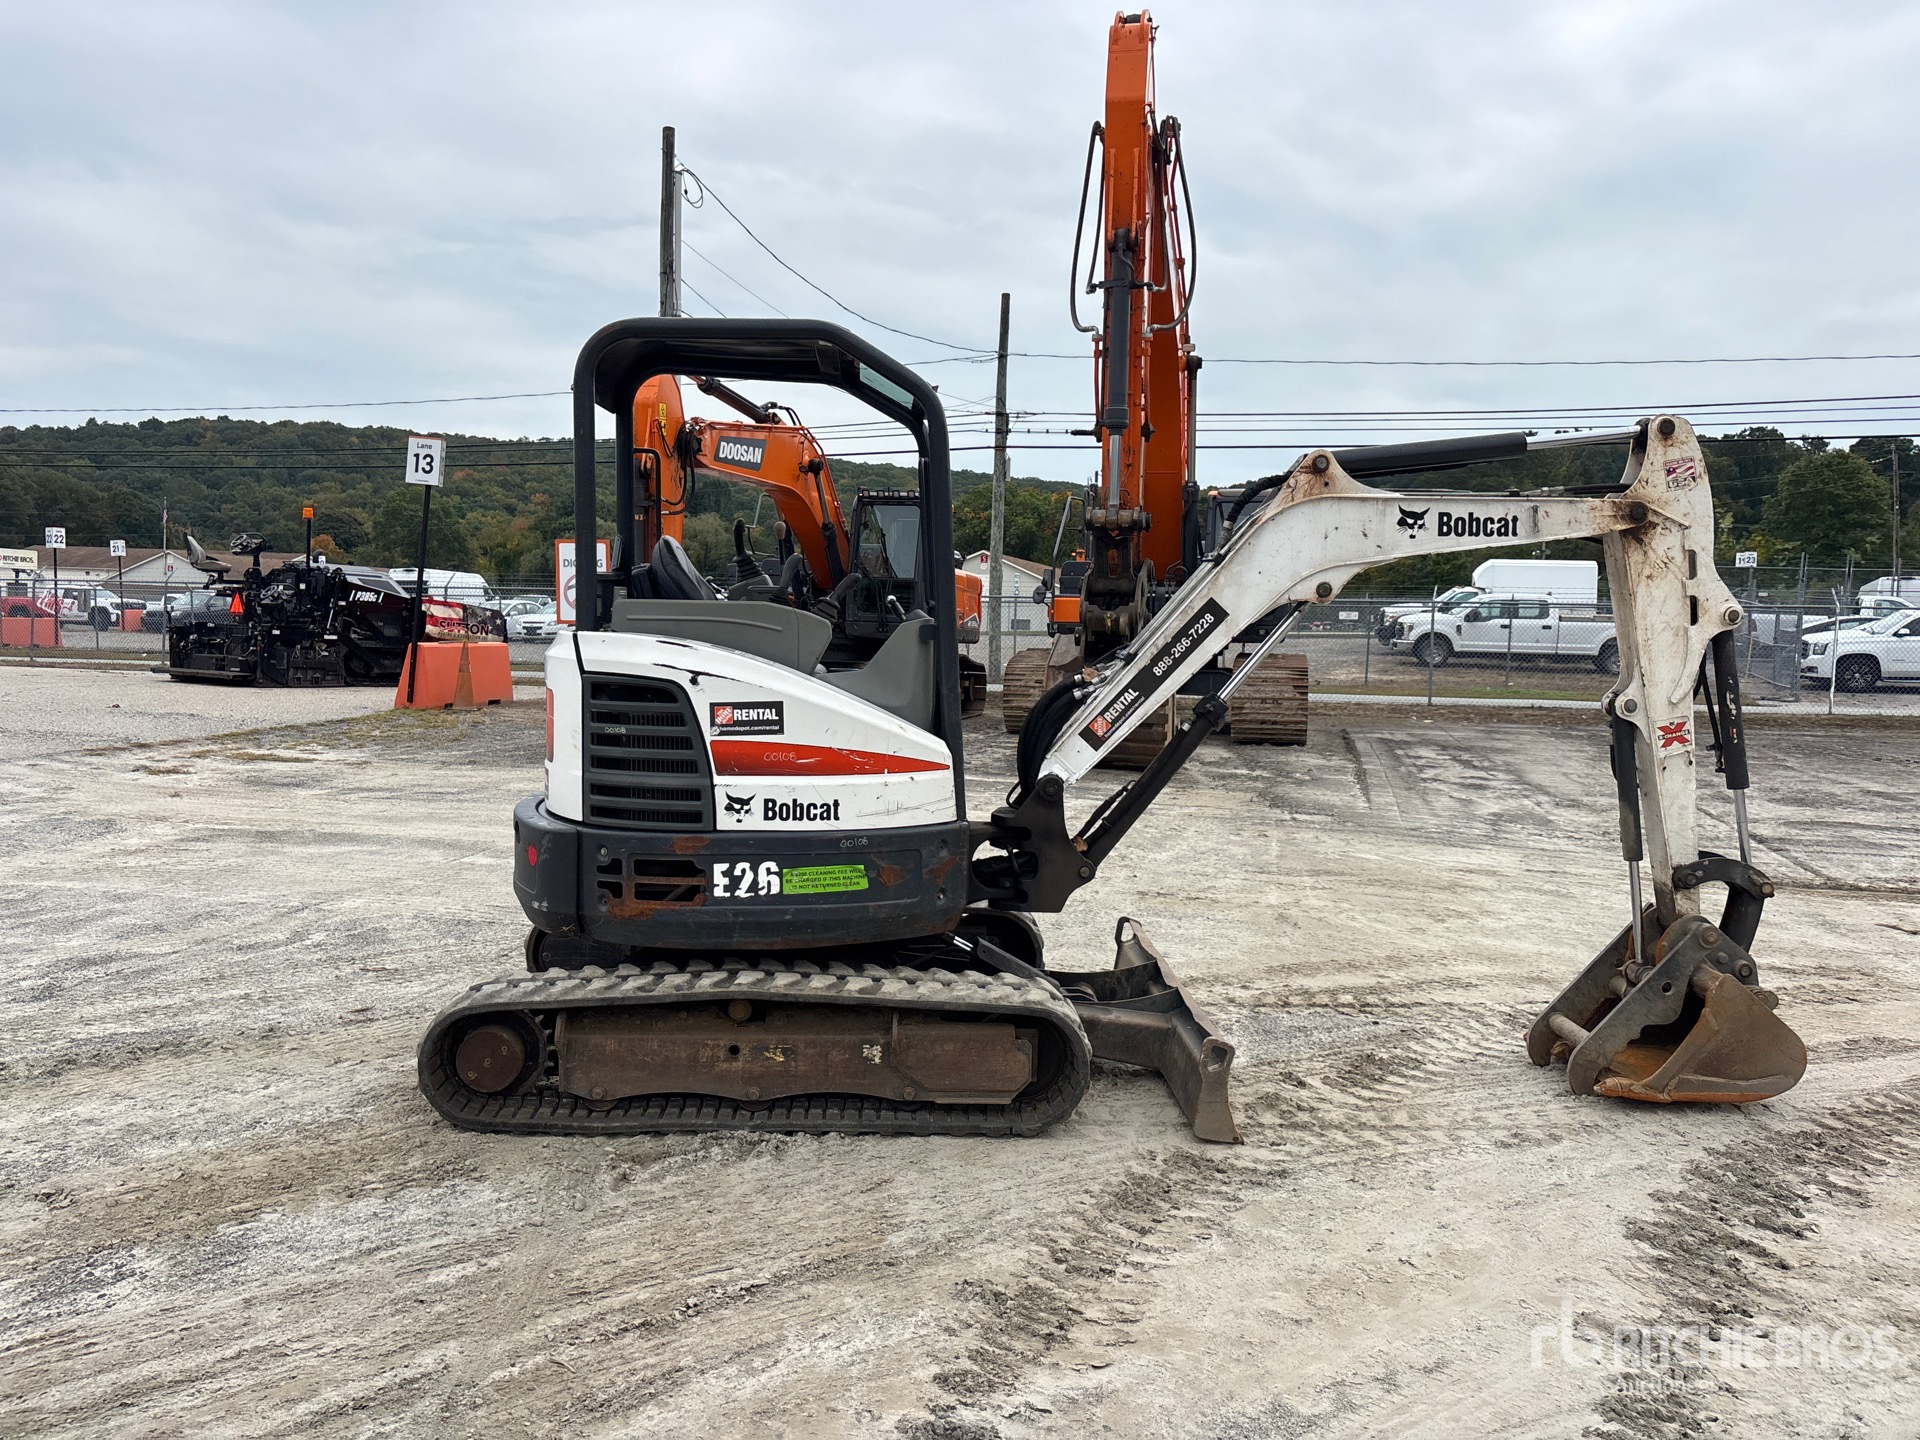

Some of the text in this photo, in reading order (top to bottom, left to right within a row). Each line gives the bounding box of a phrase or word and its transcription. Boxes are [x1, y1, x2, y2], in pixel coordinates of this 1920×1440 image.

[416, 442, 433, 450] Lane
[719, 441, 762, 463] DOOSAN
[413, 453, 434, 474] 13
[1438, 512, 1519, 537] Bobcat
[54, 534, 64, 544] 22
[112, 545, 120, 553] 21
[1746, 556, 1756, 564] 23
[355, 591, 378, 602] P385c
[1152, 613, 1215, 677] 888-266-7228
[733, 708, 779, 721] RENTAL
[1103, 688, 1139, 723] RENTAL
[763, 798, 840, 821] Bobcat
[713, 861, 781, 898] E26
